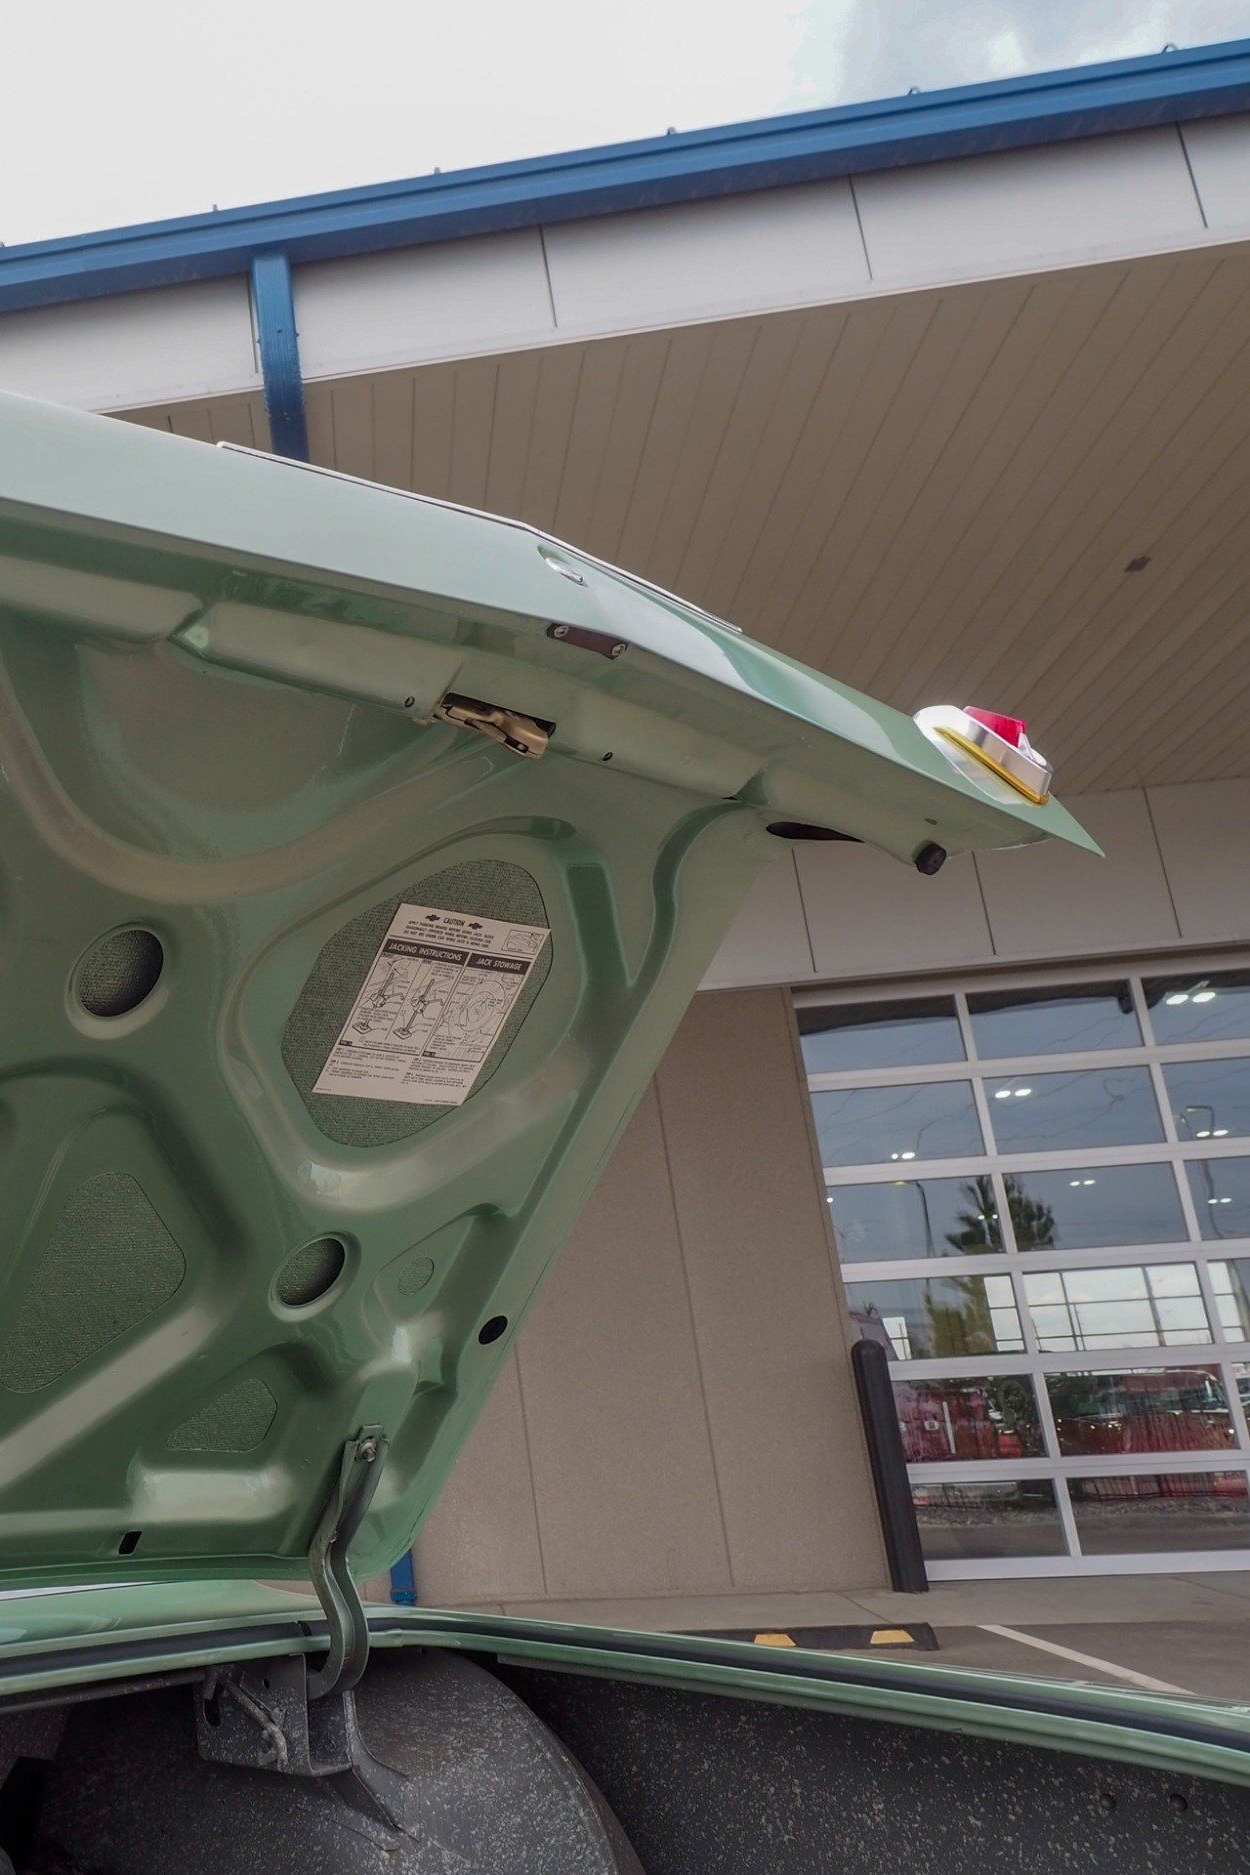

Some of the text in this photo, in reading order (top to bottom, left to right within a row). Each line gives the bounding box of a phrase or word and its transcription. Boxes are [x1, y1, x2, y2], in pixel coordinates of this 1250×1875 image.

[443, 917, 466, 927] CAUTION
[388, 942, 463, 961] JACKING INSTRUCTIONS
[476, 957, 523, 971] JACK STOWAGE
